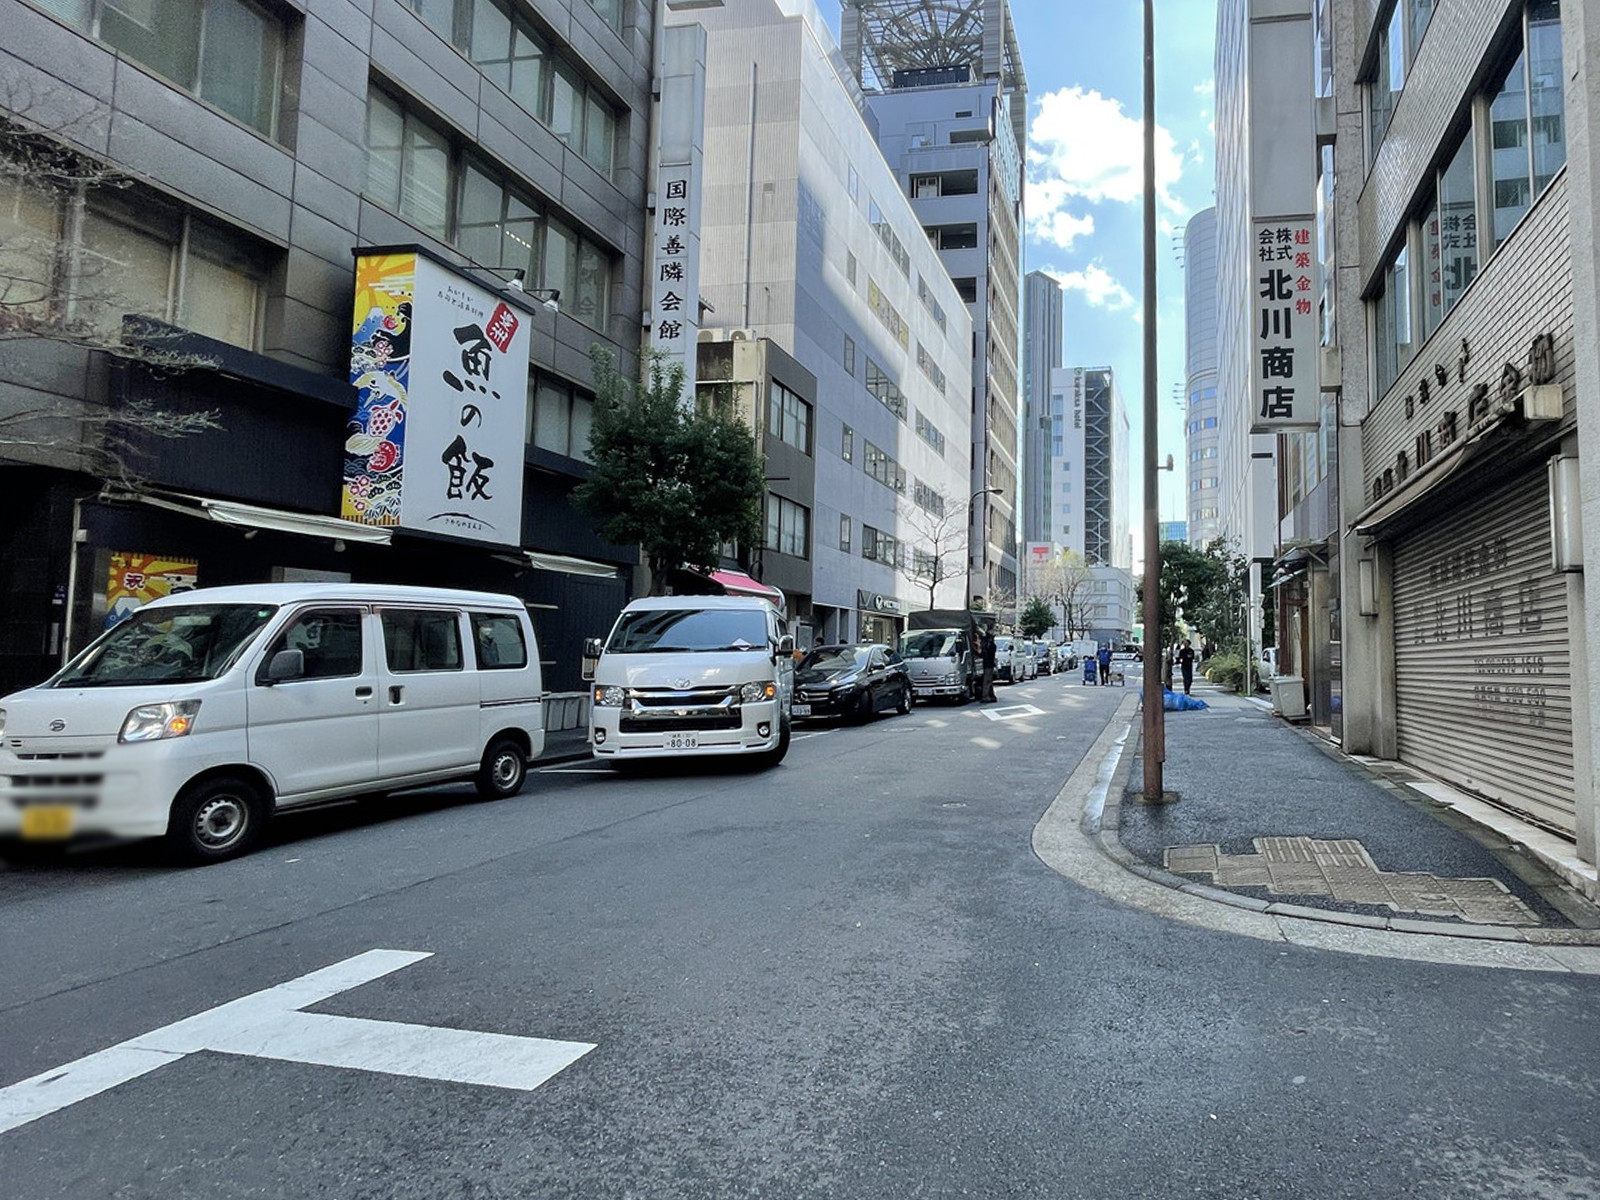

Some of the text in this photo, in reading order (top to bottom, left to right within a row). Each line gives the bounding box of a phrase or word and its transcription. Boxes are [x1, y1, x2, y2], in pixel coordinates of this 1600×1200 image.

[659, 179, 687, 340] 国際善隣会館
[1294, 229, 1311, 314] 建築金物
[441, 322, 501, 502] 魚の飯
[1259, 269, 1294, 419] 北川商店
[125, 573, 145, 590] 祝
